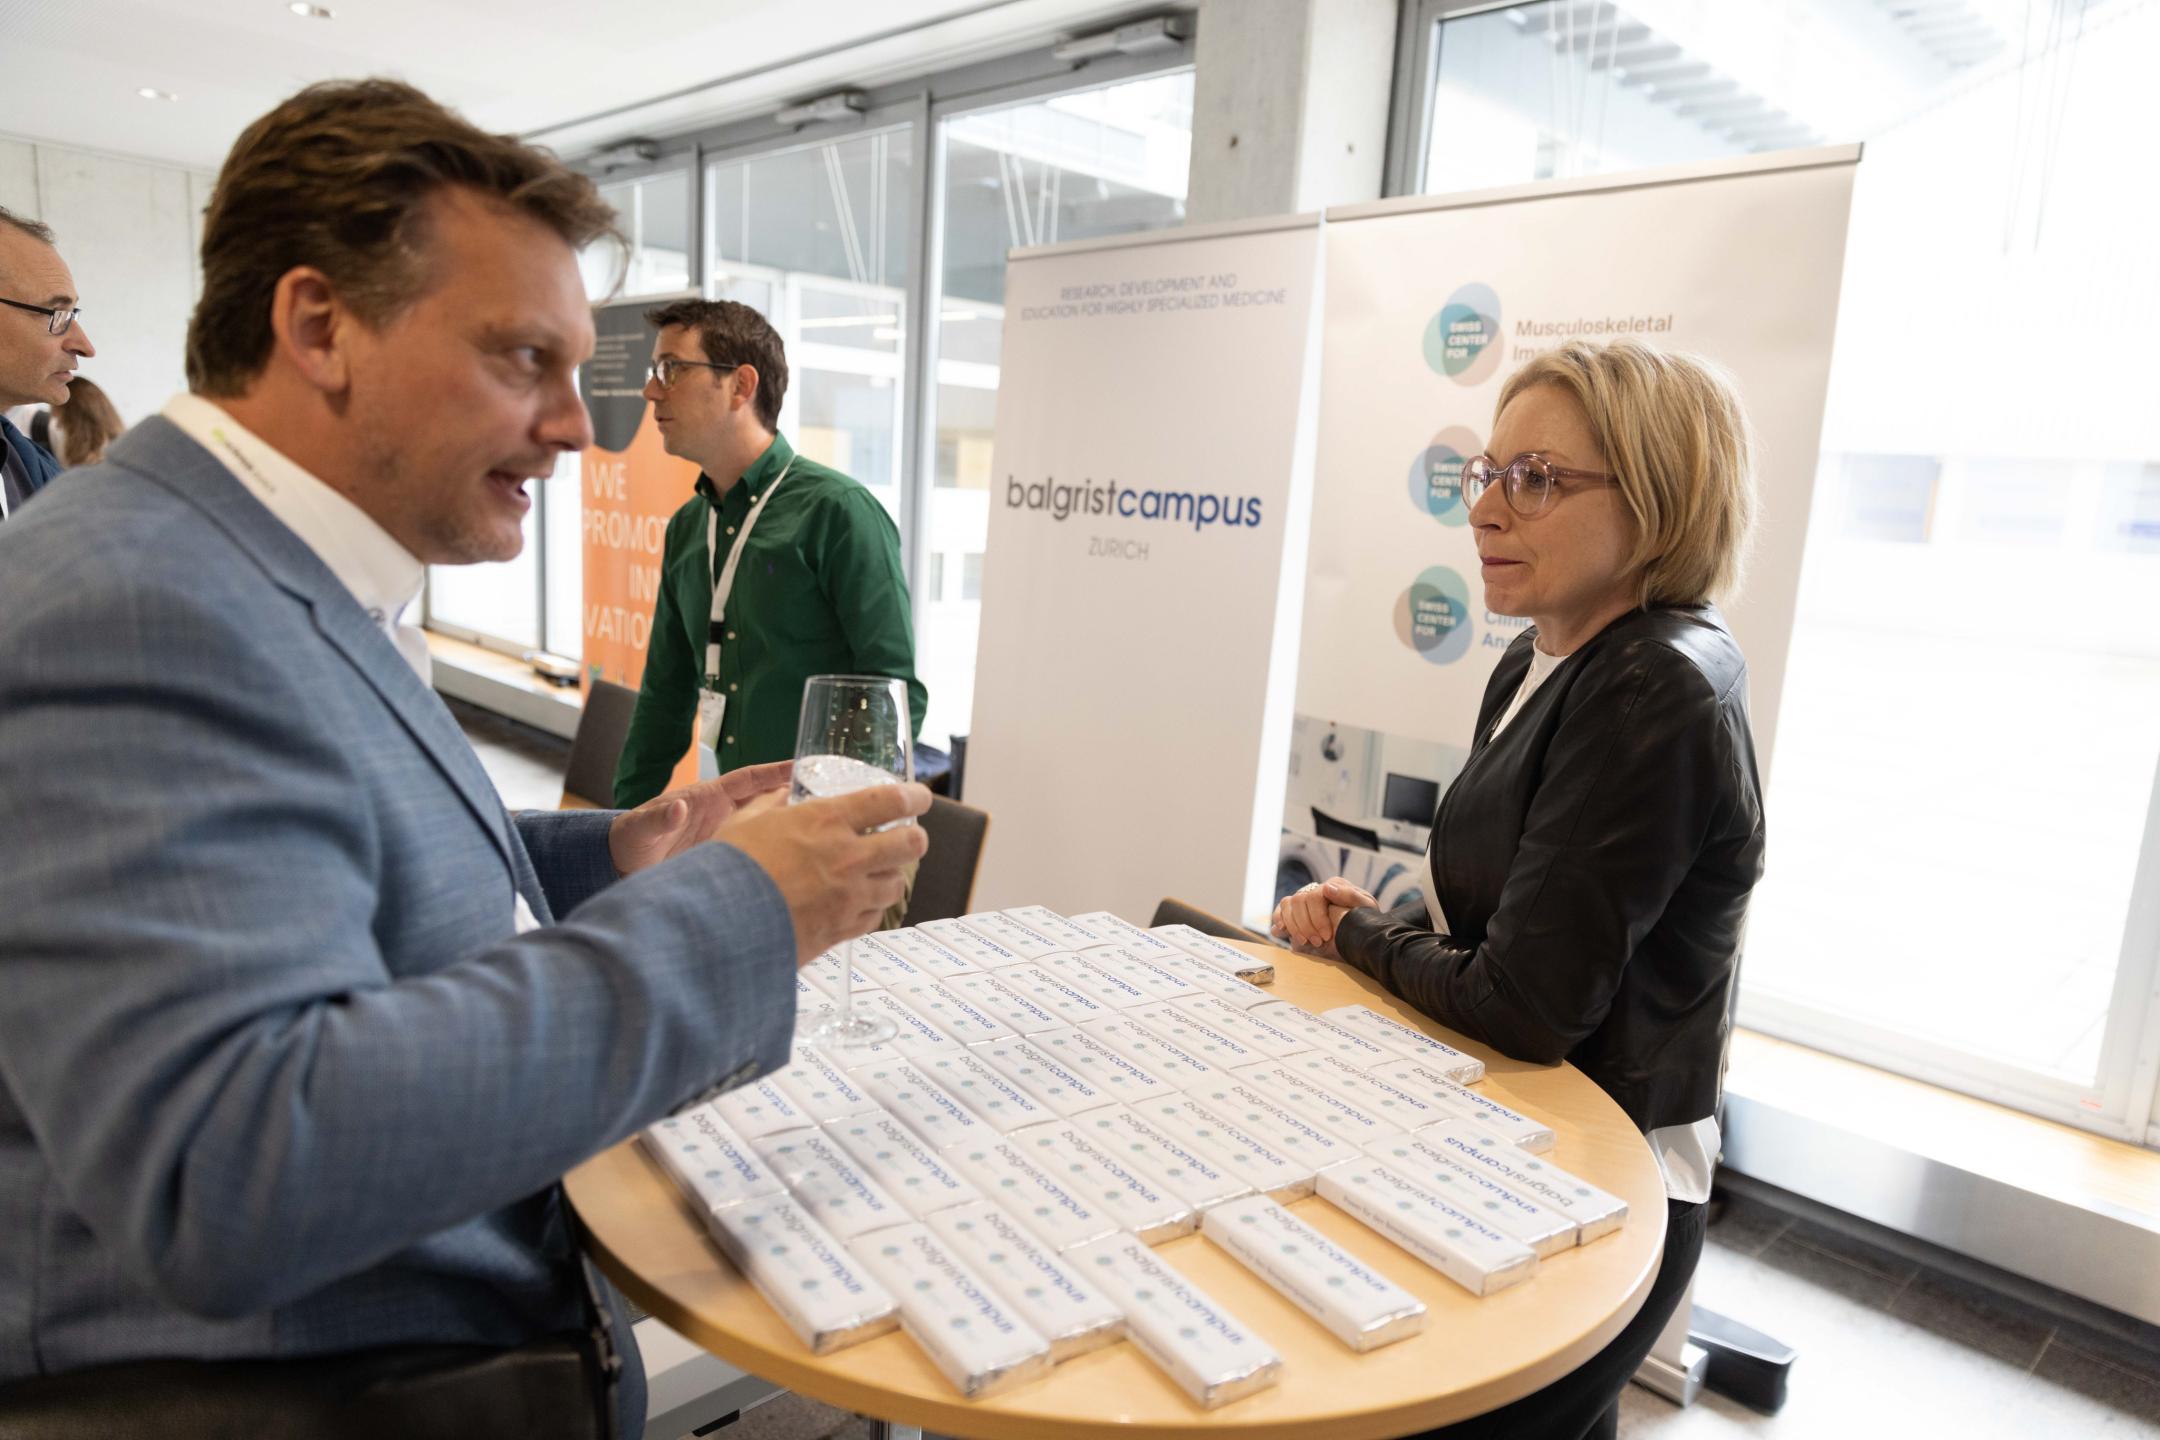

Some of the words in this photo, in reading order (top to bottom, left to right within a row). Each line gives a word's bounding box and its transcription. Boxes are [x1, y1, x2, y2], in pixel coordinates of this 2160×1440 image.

[1119, 276, 1205, 297] DEVELOPMENT
[1209, 274, 1238, 289] AND
[1021, 304, 1079, 321] EDUCATION
[1081, 302, 1101, 317] FOR
[1105, 300, 1143, 316] HIGHLY
[1148, 293, 1219, 313] SPECIALIZED
[1221, 288, 1287, 307] MEDICINE
[1447, 334, 1489, 347] CENTER
[1515, 315, 1673, 337] Musculoskeletal
[1445, 348, 1470, 360] FOR
[590, 463, 627, 501] WE
[1431, 475, 1462, 488] CENTE
[1006, 474, 1262, 532] balgristcampus
[1088, 536, 1151, 561] ZURICH
[583, 603, 654, 650] VATIO
[1162, 1008, 1248, 1055] balgristcampus
[1290, 1006, 1382, 1054] balgristcampus
[1361, 1010, 1459, 1057] balgristcampus
[1412, 1067, 1525, 1123] balgristcampus
